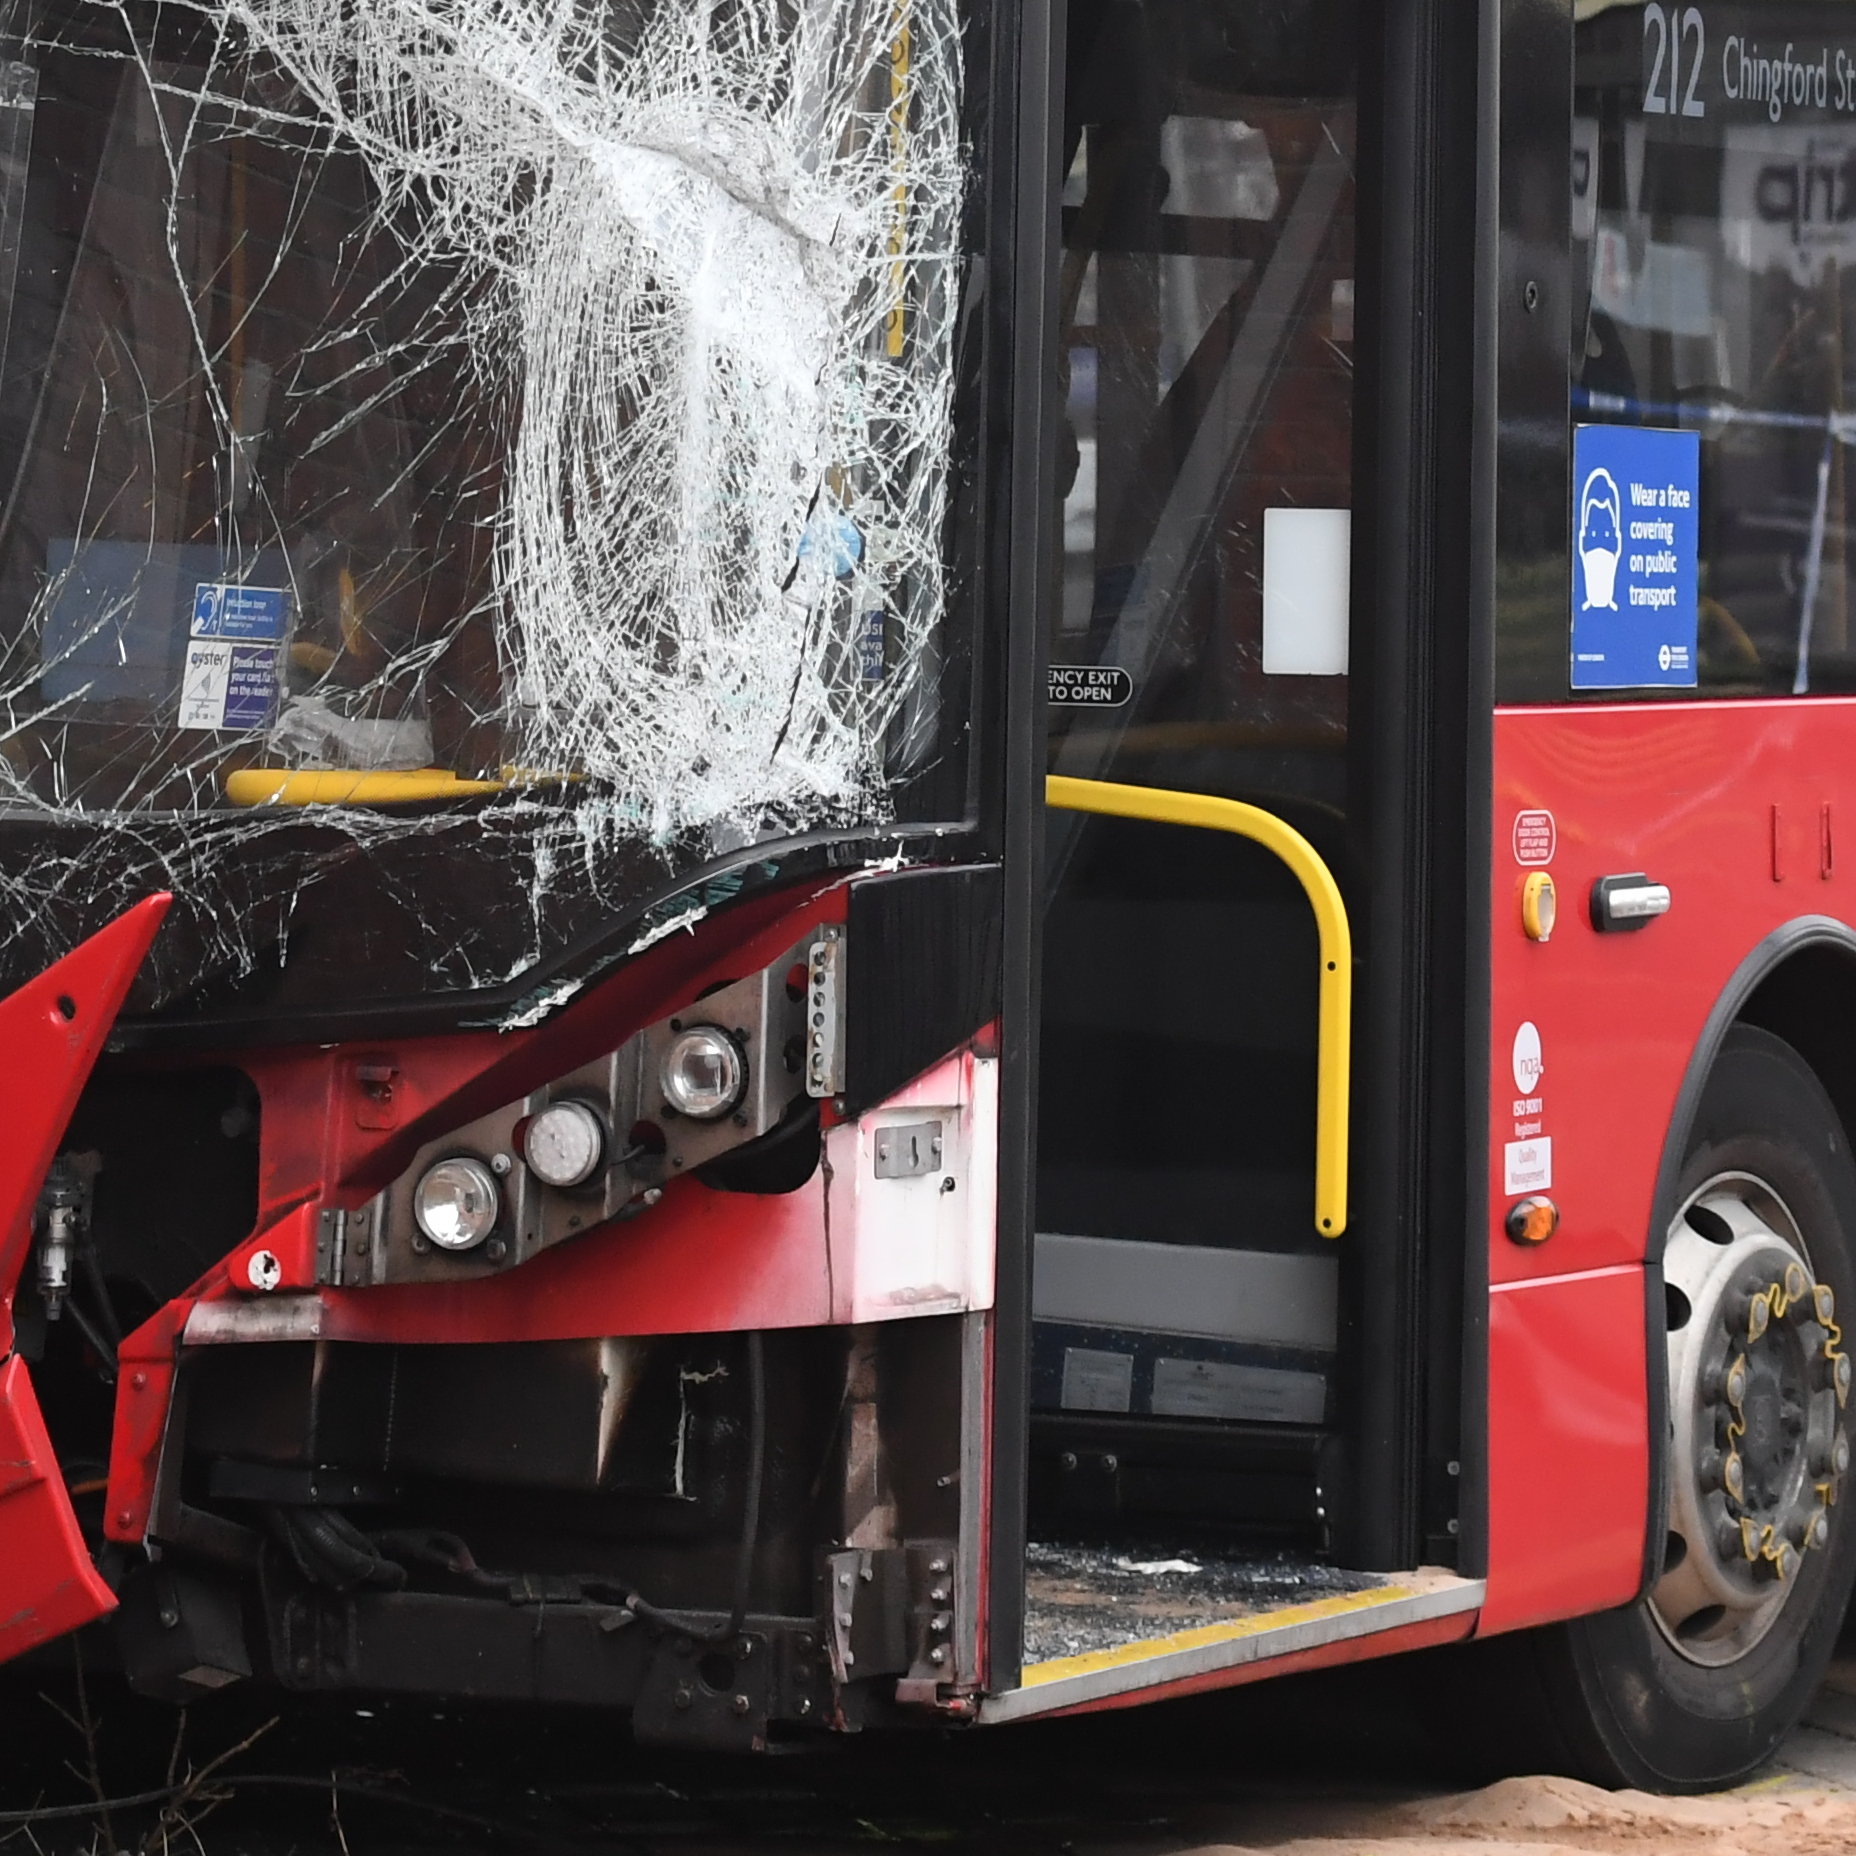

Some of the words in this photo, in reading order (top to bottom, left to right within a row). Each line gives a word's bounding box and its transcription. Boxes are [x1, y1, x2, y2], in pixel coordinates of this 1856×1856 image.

[1644, 2, 1706, 118] 212
[1723, 35, 1828, 122] Chingford
[1630, 482, 1657, 507] Wear
[1659, 491, 1666, 506] a
[1667, 483, 1690, 508] face
[1630, 518, 1674, 545] covering
[1630, 556, 1643, 572] on
[1645, 551, 1677, 578] public
[1629, 585, 1677, 611] transport
[191, 652, 226, 669] oyster
[1088, 671, 1120, 685] EXIT
[1048, 686, 1068, 700] TO
[1071, 686, 1112, 700] OPEN
